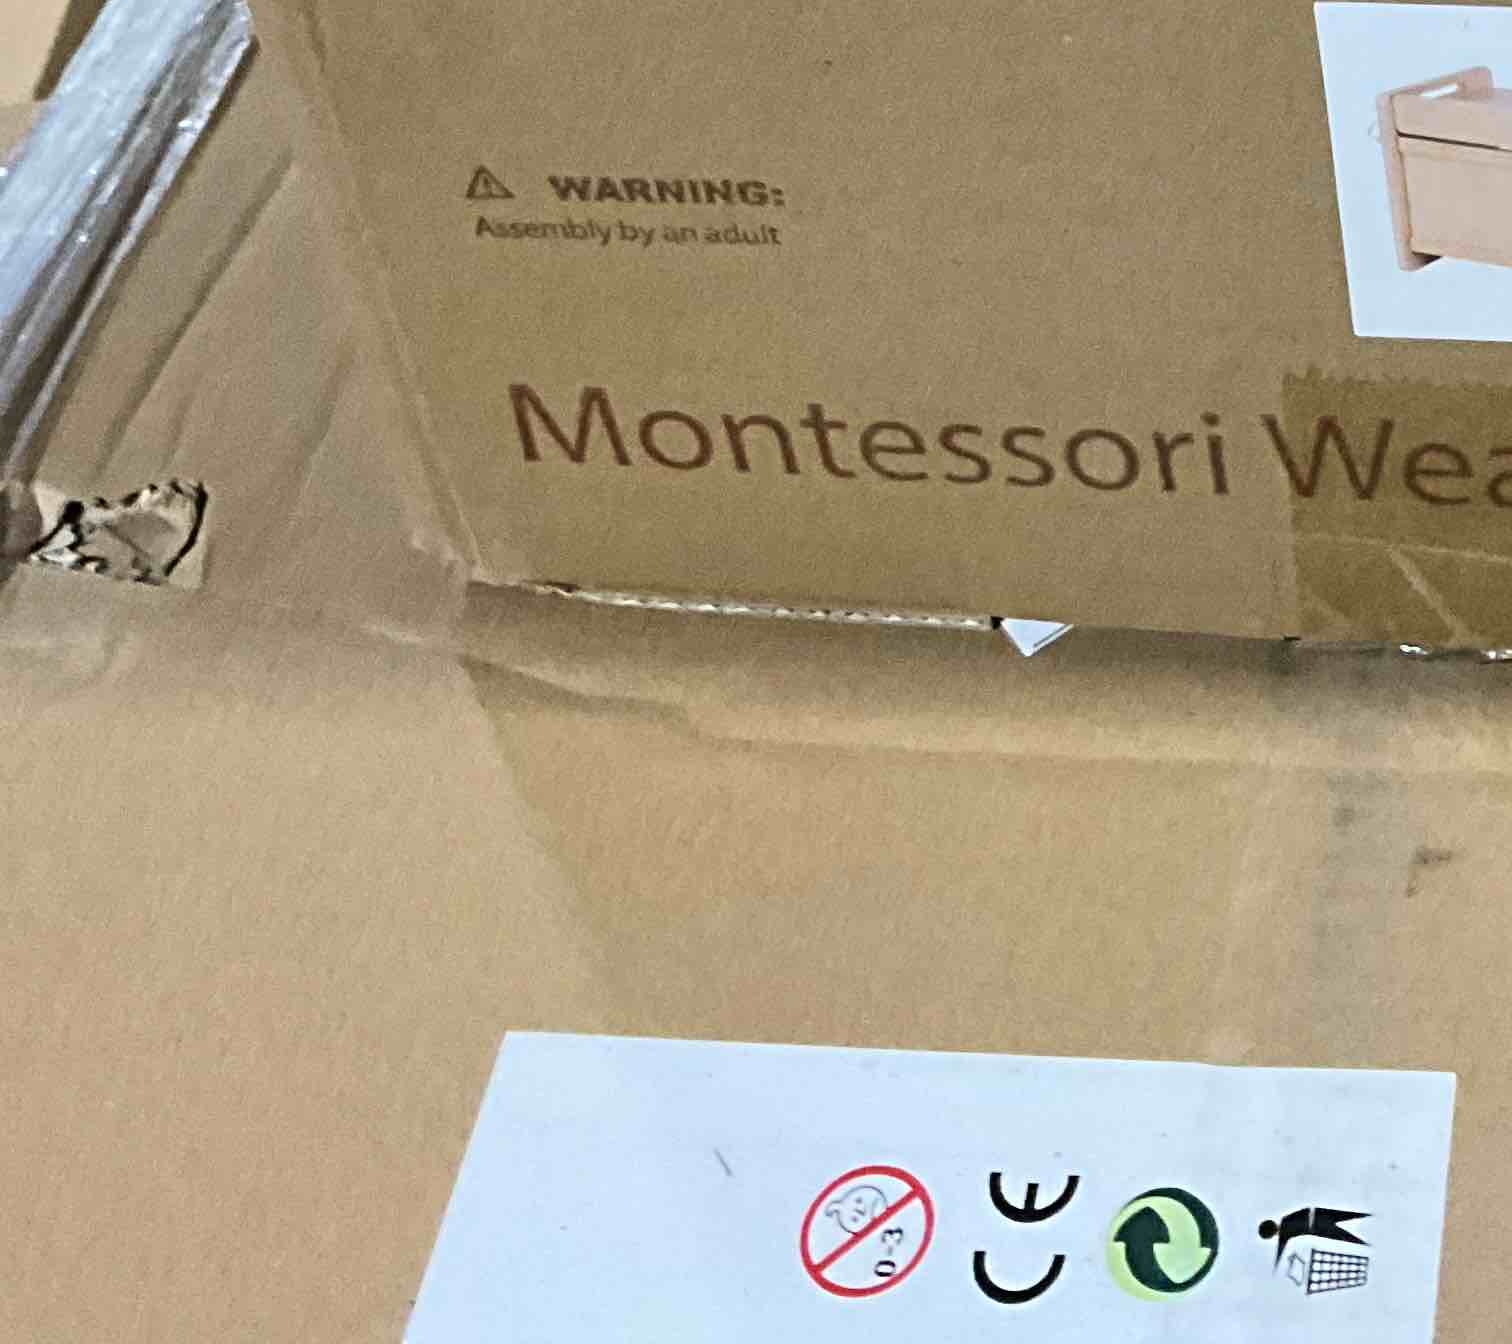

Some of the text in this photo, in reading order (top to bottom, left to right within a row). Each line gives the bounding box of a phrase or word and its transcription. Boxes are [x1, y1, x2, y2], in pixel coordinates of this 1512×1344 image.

[548, 176, 787, 208] WARNING:
[475, 215, 782, 247] Assembly by an adult
[508, 383, 1231, 496] Montessori
[873, 1226, 904, 1278] 0-3
[972, 1170, 1081, 1305] CE
